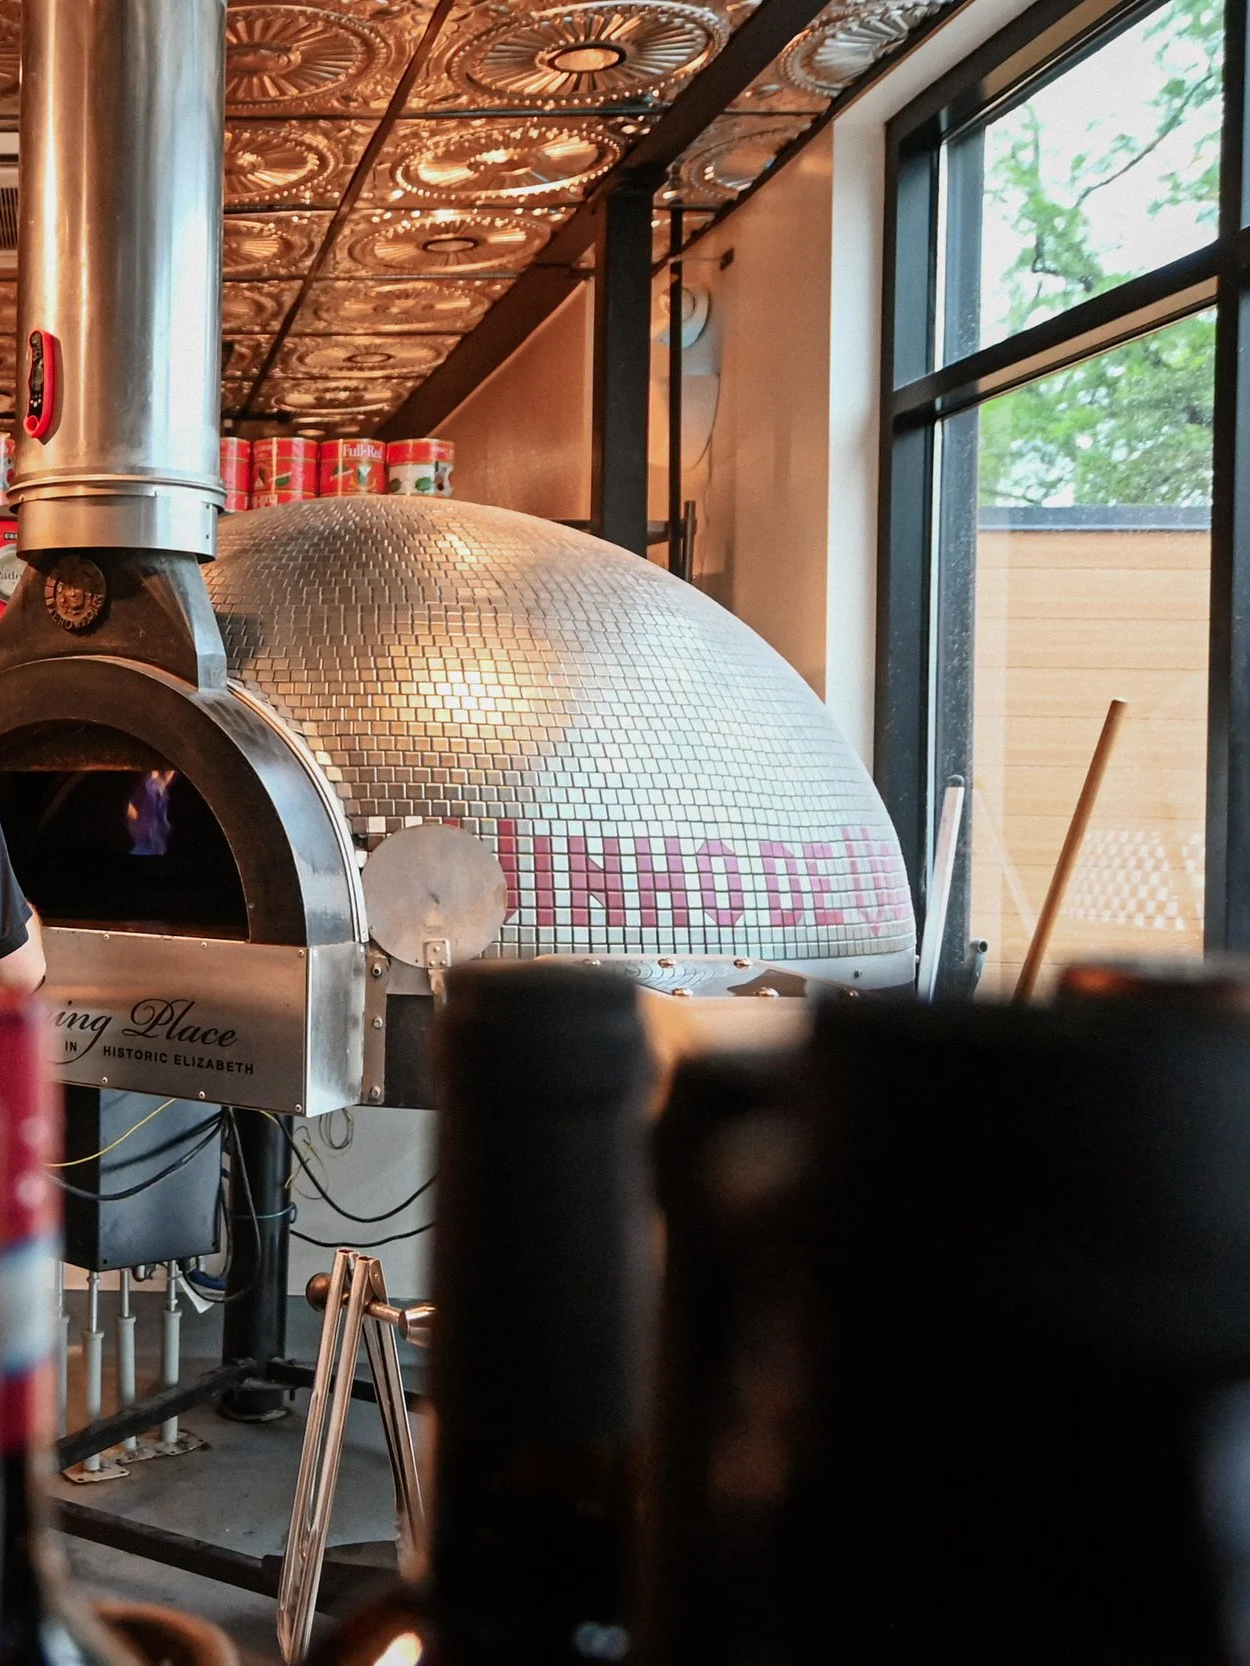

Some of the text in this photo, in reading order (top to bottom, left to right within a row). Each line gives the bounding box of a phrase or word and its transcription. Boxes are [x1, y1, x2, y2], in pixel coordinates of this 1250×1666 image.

[121, 998, 238, 1048] Place
[64, 1040, 255, 1075] IN HISTORIC ELIZABETH
